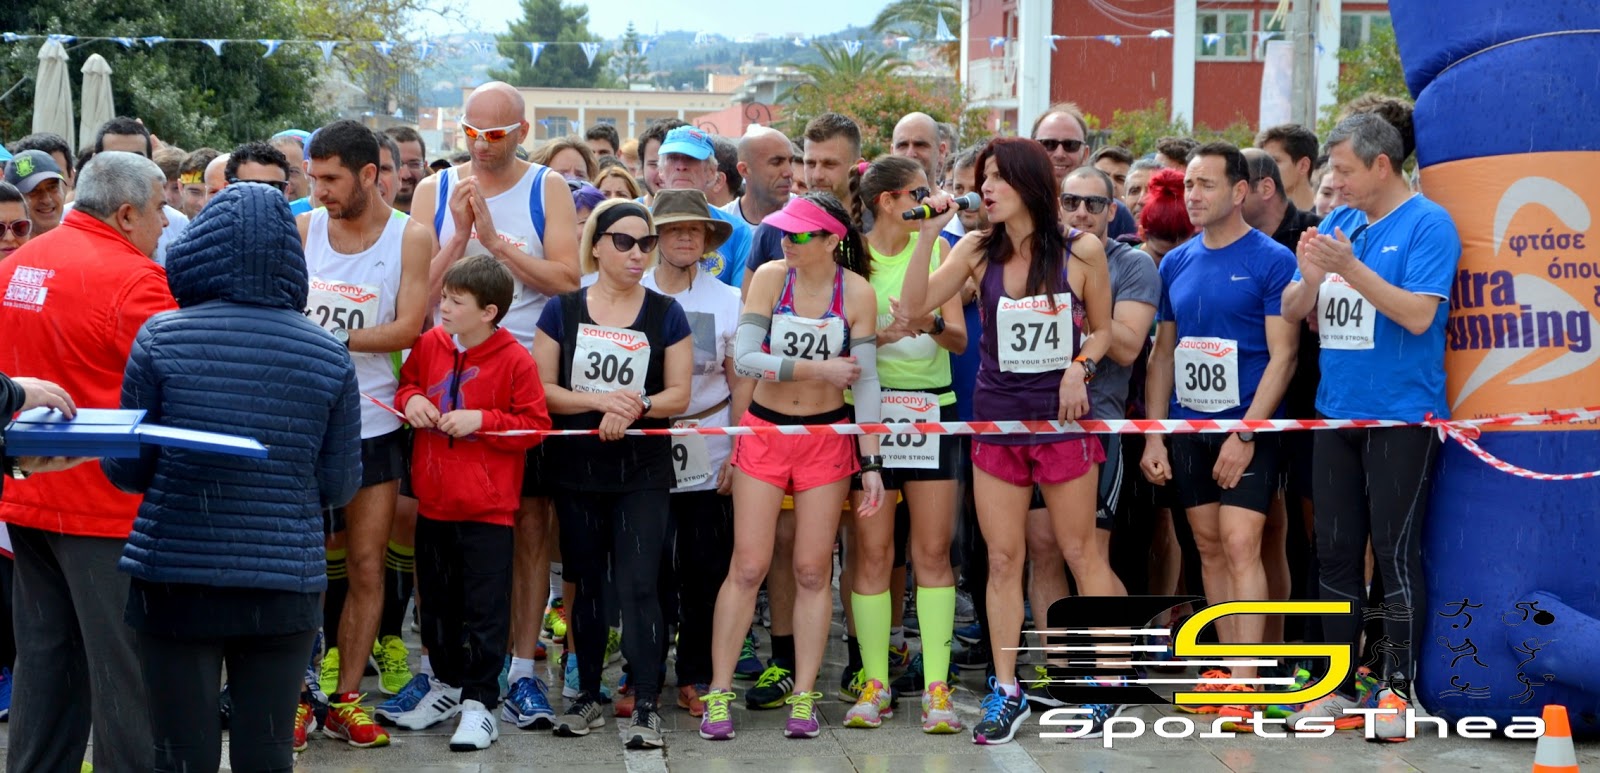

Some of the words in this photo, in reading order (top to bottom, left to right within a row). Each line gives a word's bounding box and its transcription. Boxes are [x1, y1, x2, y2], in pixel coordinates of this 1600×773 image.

[1509, 228, 1586, 257] φτάσε
[311, 281, 363, 297] saucony
[1449, 269, 1516, 311] ltra
[315, 305, 365, 330] 250
[1325, 297, 1364, 328] 404
[582, 327, 636, 345] saucony
[782, 331, 831, 361] 324
[1010, 321, 1060, 353] 374
[1179, 340, 1222, 352] saucony
[584, 351, 634, 386] 306
[1042, 355, 1069, 364] STRONG
[574, 384, 590, 392] FIND
[1185, 362, 1227, 392] 308
[672, 443, 688, 471] 9
